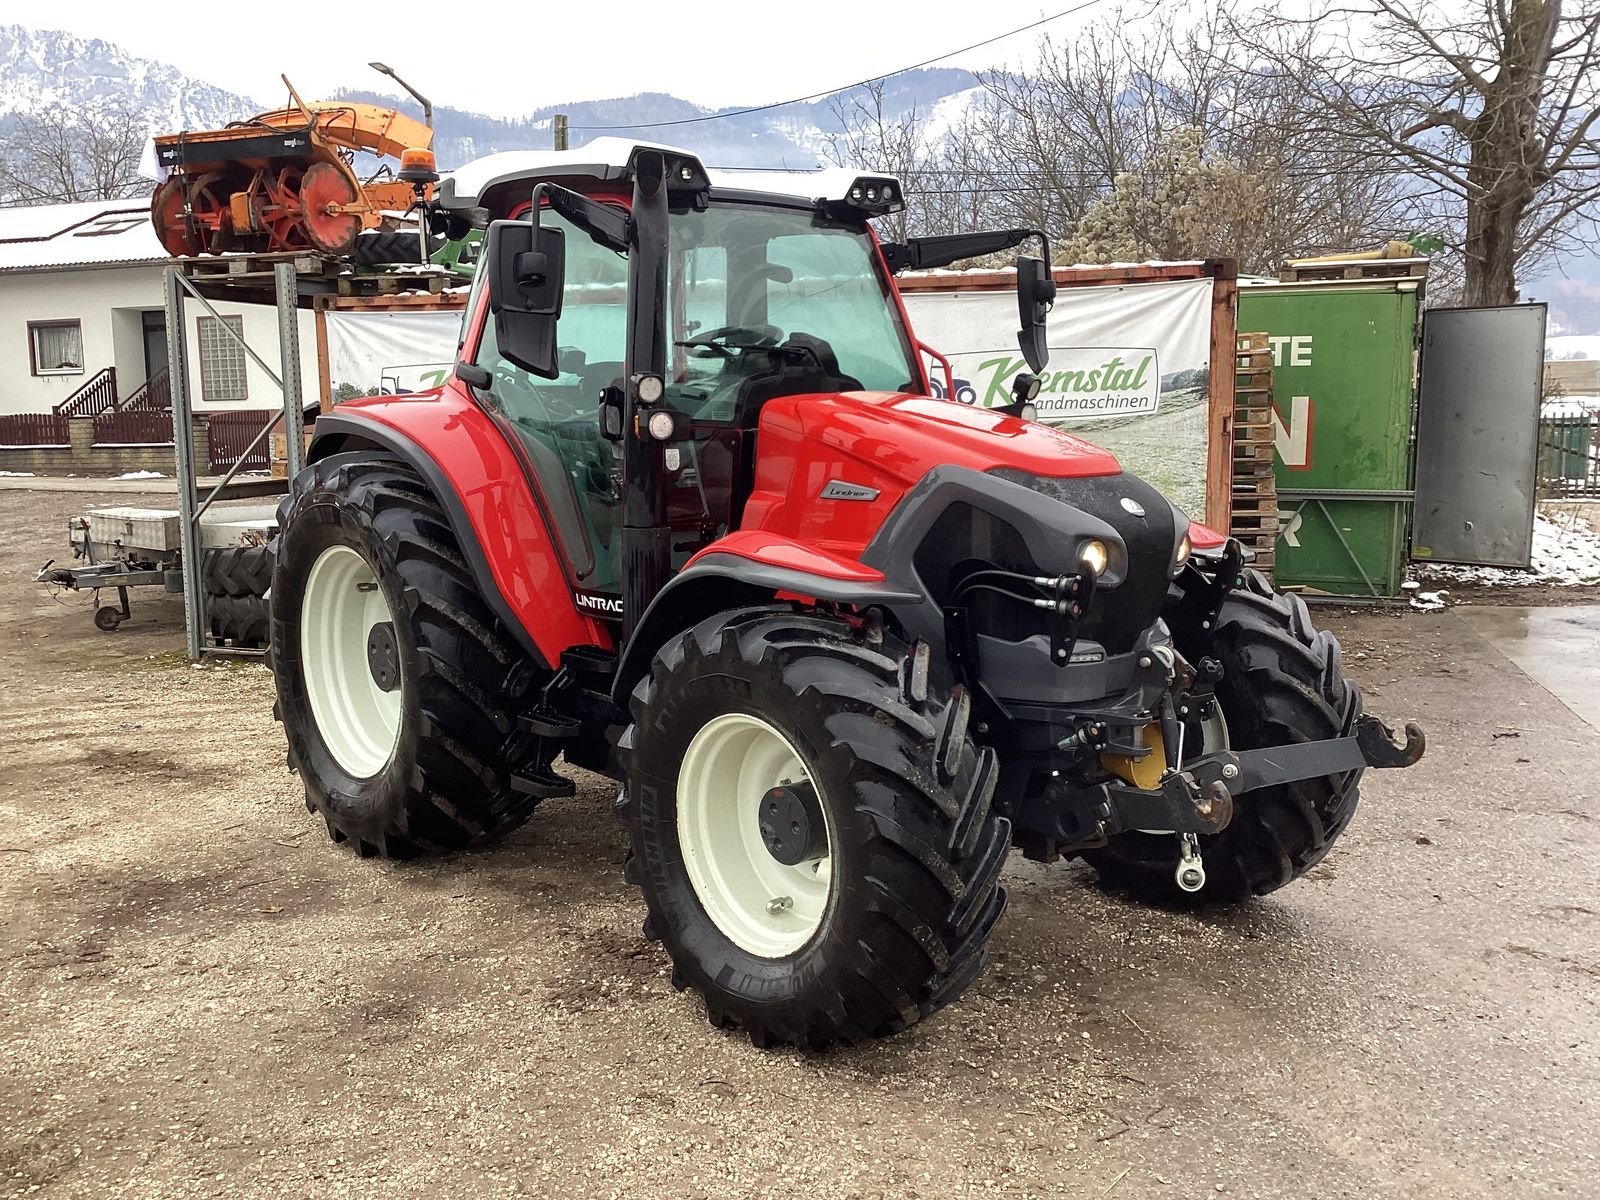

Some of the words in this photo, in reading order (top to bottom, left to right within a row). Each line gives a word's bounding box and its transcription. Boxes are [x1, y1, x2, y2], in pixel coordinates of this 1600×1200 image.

[977, 356, 1153, 408] Kemstal
[1033, 394, 1148, 411] andmaschinen
[830, 487, 868, 497] Lindner
[575, 593, 624, 612] LINTRAC
